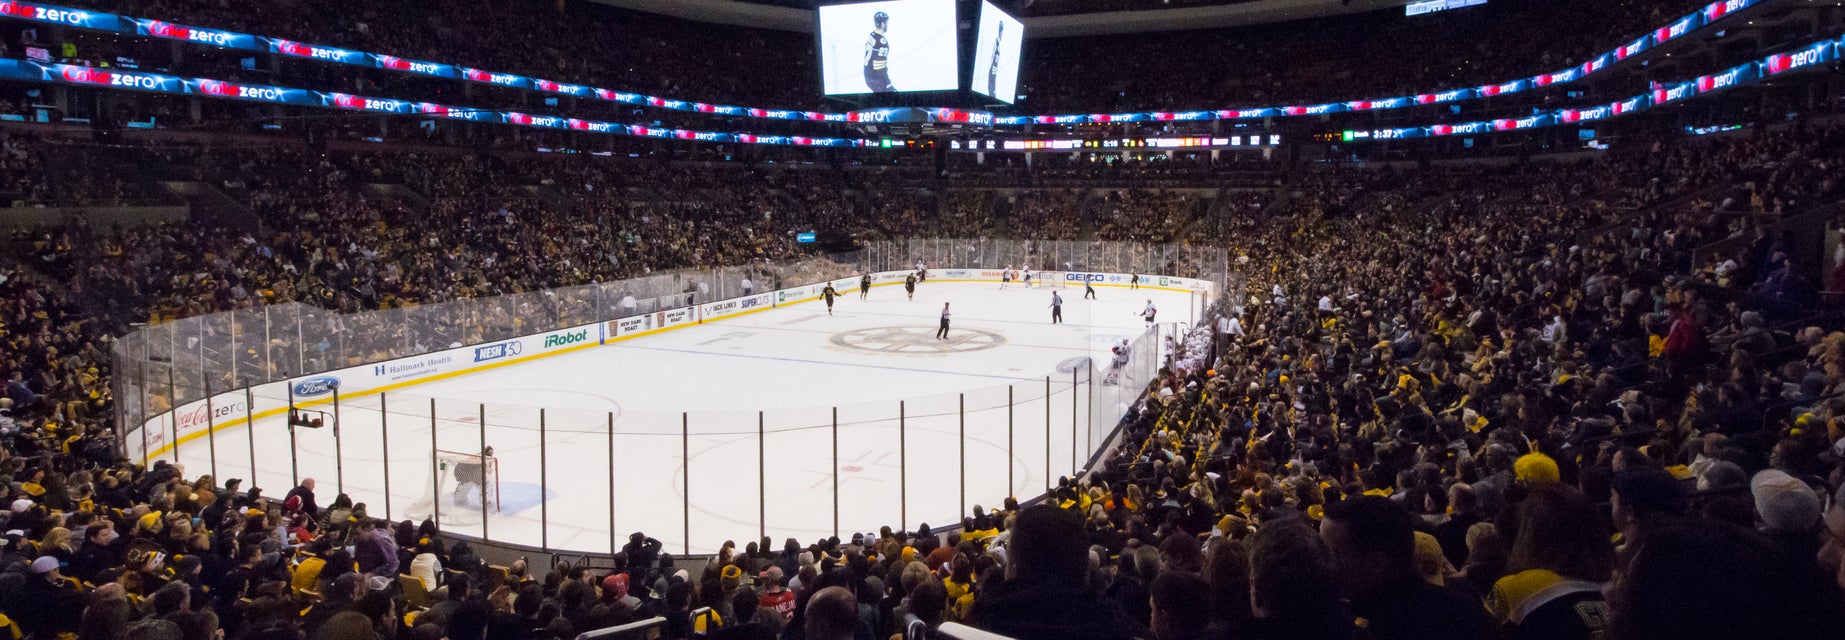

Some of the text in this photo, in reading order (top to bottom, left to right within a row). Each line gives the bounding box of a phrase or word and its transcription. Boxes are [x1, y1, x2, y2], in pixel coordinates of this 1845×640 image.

[544, 329, 587, 348] iRobot
[389, 361, 425, 374] Hallmark
[427, 355, 452, 366] Health
[215, 402, 246, 418] zero
